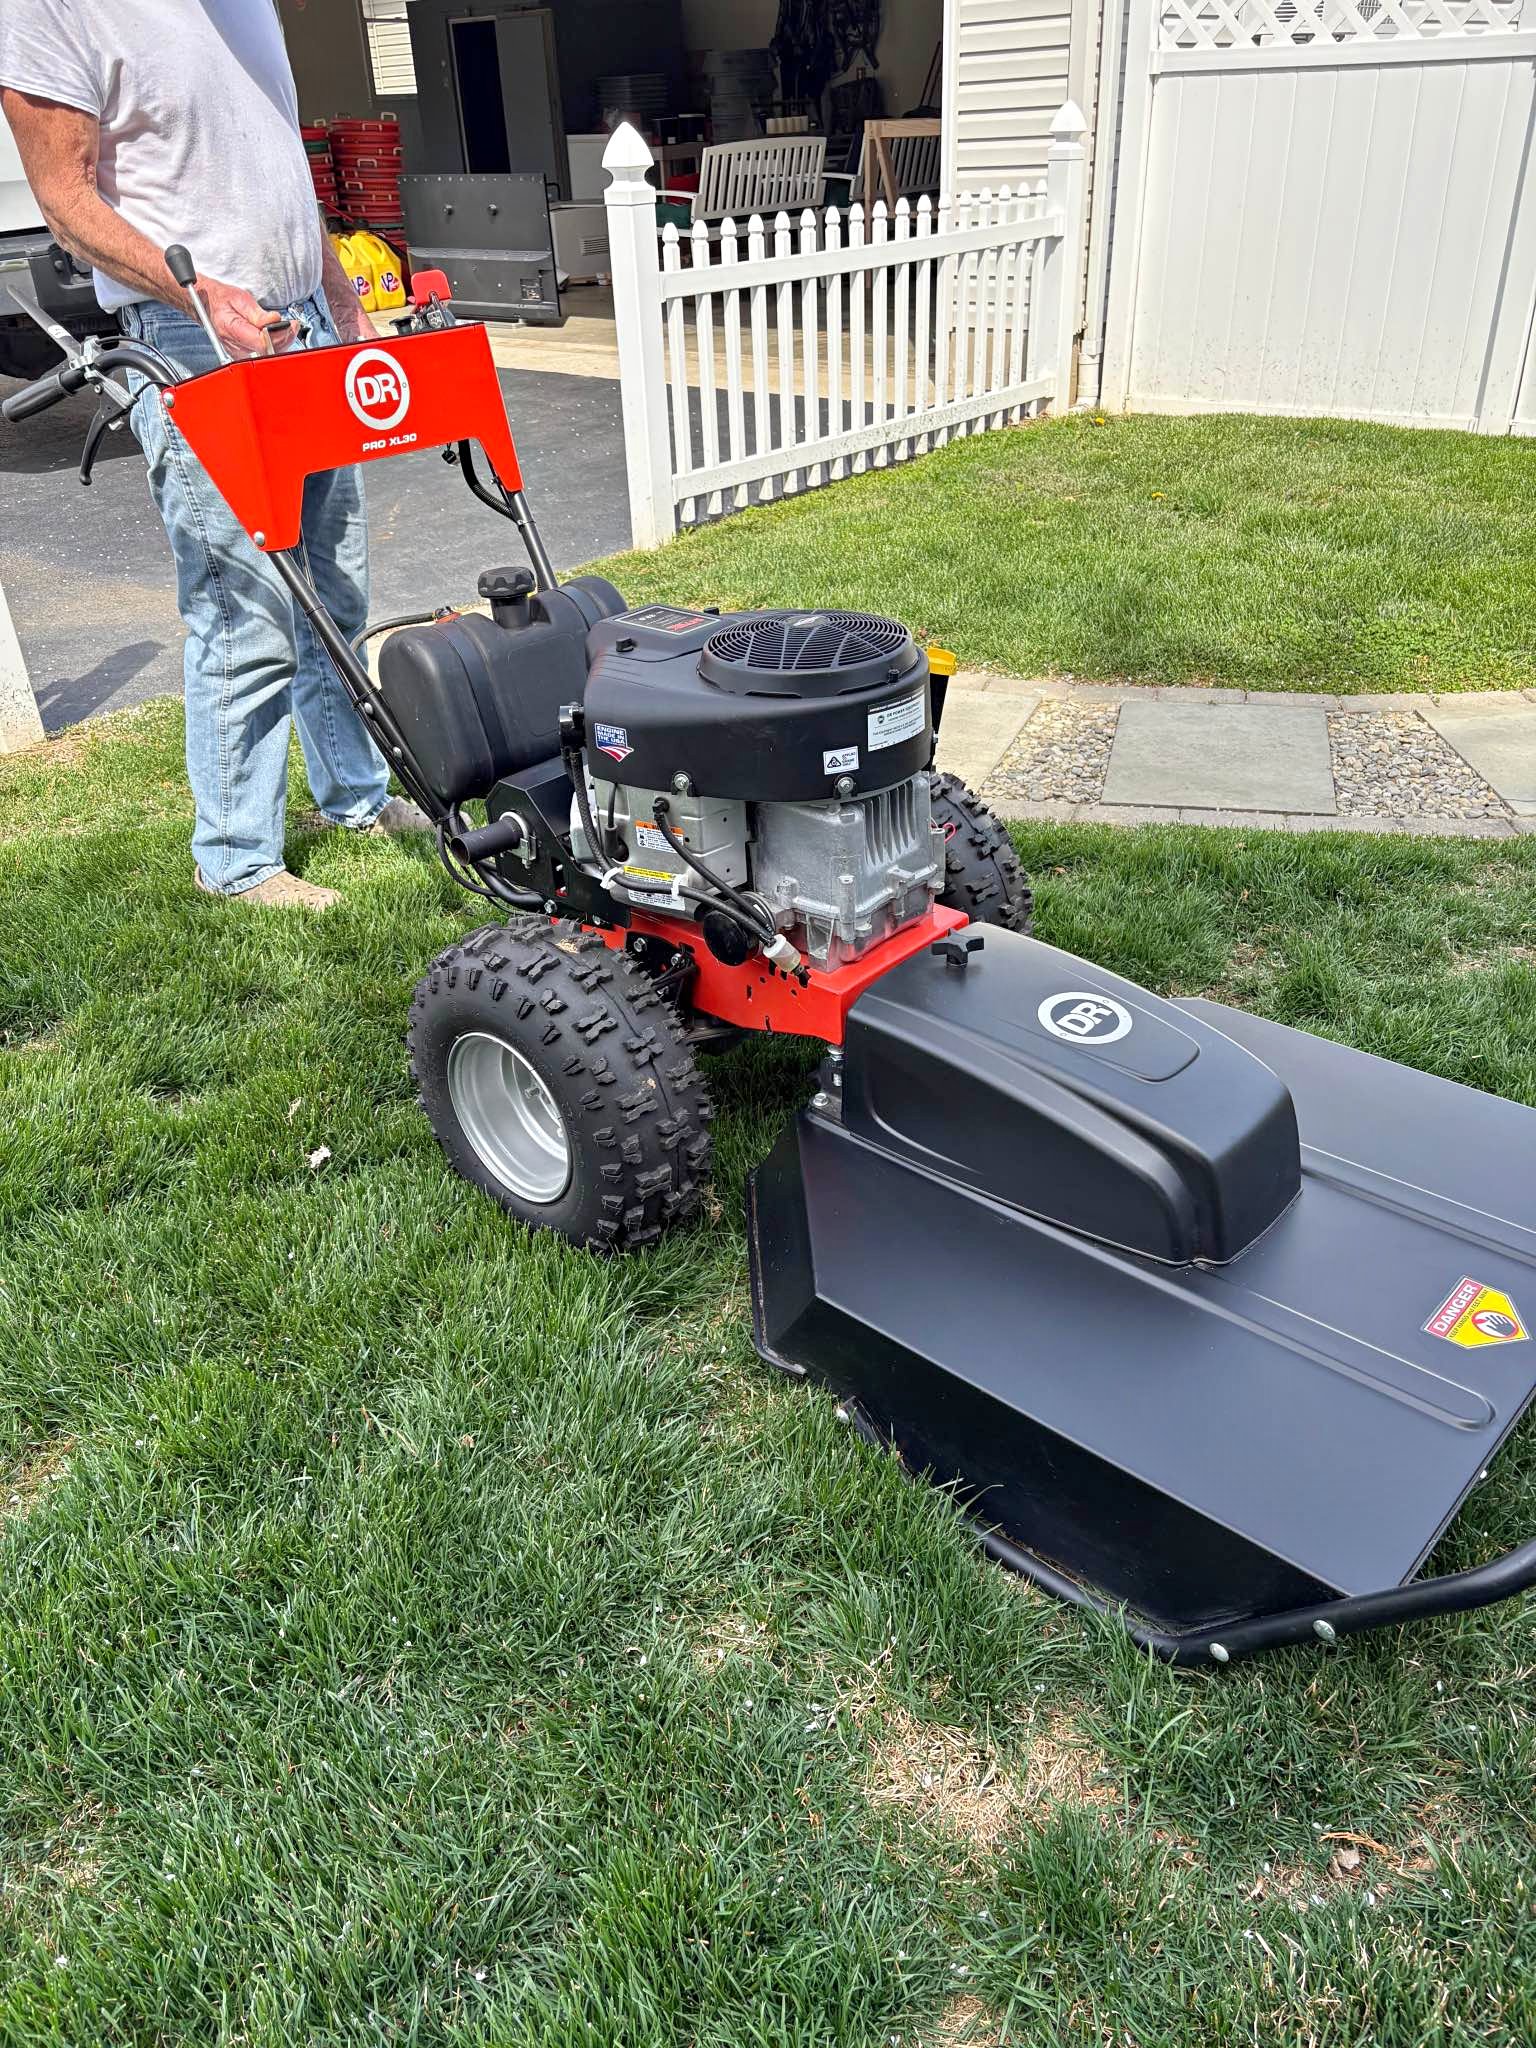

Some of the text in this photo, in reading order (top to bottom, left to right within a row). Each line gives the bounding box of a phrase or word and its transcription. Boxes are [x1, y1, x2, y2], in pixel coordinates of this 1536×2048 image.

[356, 373, 400, 407] DR
[362, 433, 417, 452] PRO XL30
[597, 725, 625, 736] ENGINE
[597, 731, 616, 739] MADE
[598, 734, 611, 743] THE
[1056, 1002, 1113, 1035] DR
[1433, 1284, 1477, 1333] DANGER
